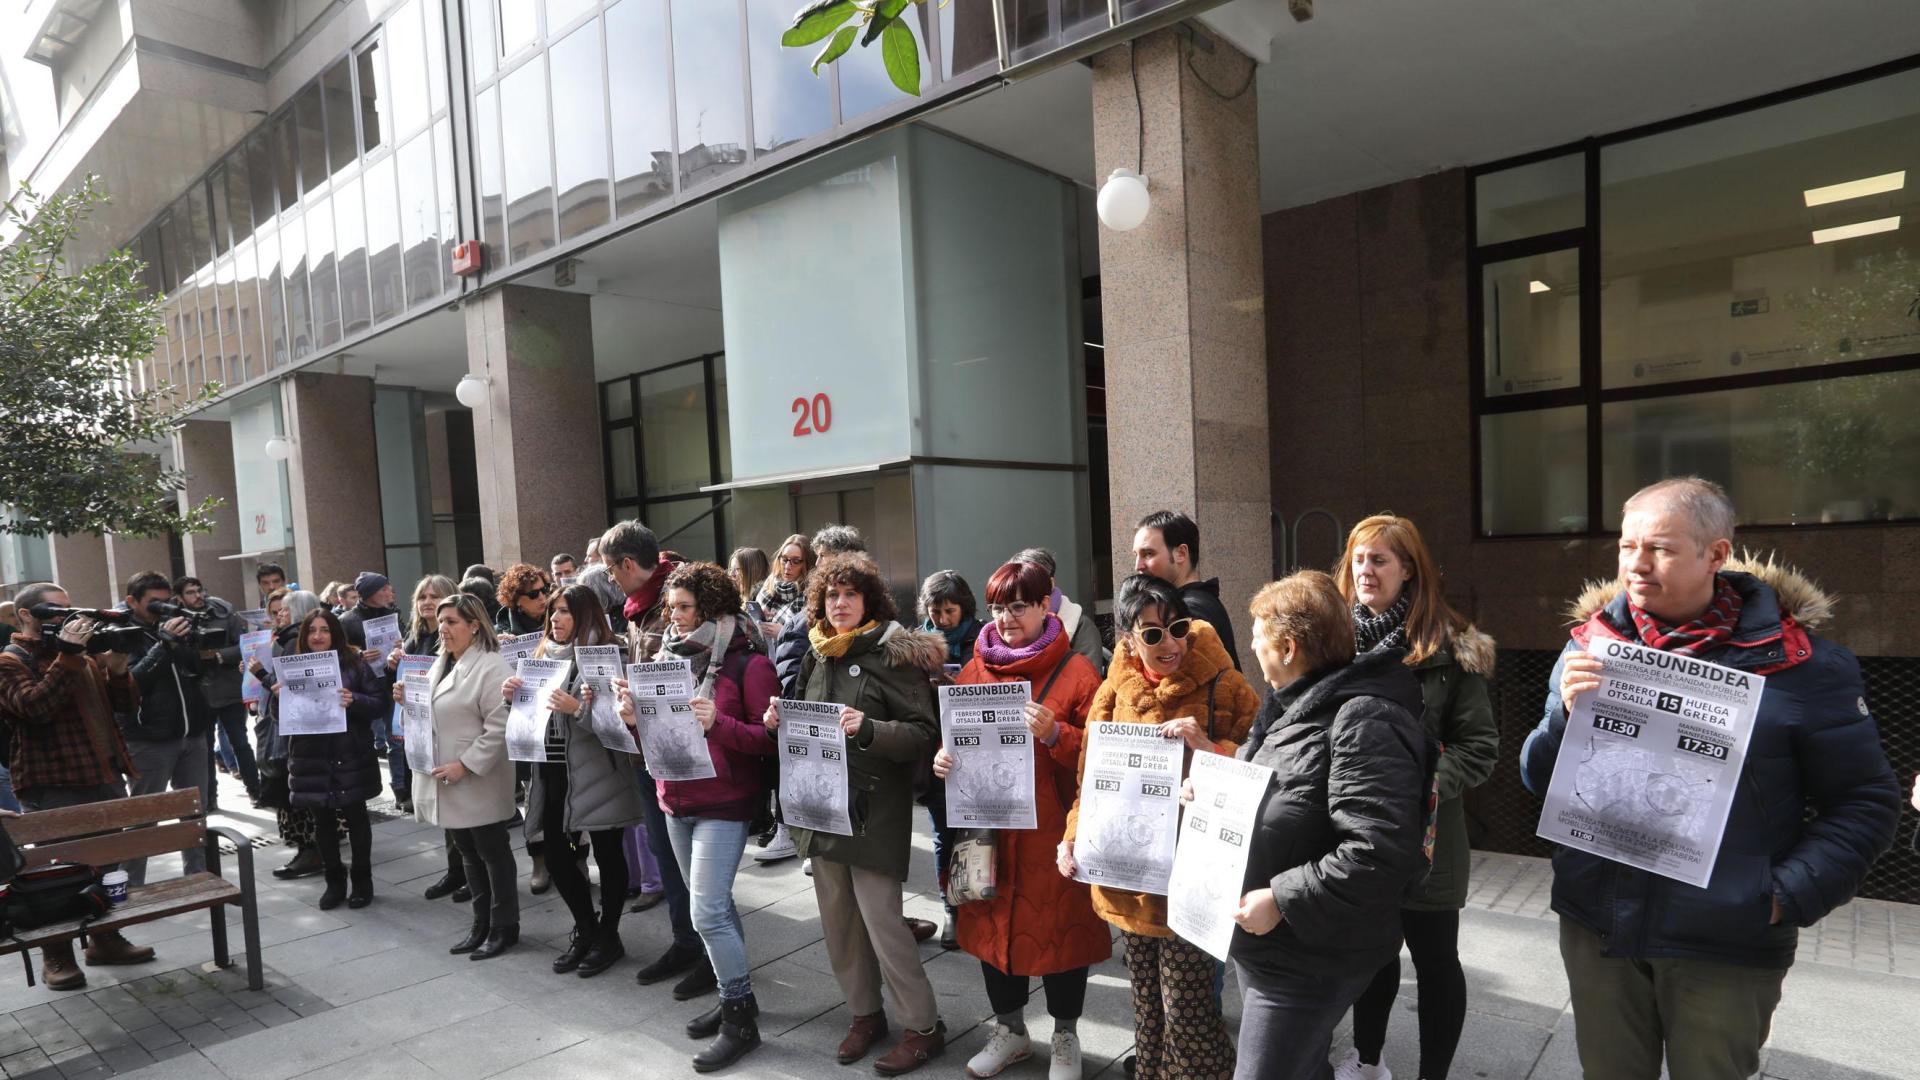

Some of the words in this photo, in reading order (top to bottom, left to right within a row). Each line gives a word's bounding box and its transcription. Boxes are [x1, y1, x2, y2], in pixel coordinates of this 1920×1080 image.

[792, 393, 831, 437] 20
[256, 514, 266, 534] 22
[280, 652, 334, 664] OSASUNBIDEA
[633, 662, 686, 673] OSASUNBIDEA
[1607, 642, 1750, 690] OSASUNBIDEA
[1614, 660, 1649, 675] DEFENSA
[1650, 668, 1661, 677] DE
[1662, 671, 1672, 680] LA
[1675, 674, 1710, 688] SANIDAD
[1713, 683, 1748, 698] PÚBLICA
[948, 685, 1025, 696] OSASUNBIDEA
[1610, 680, 1656, 698] FEBRERO
[1661, 696, 1678, 710] 15
[1686, 699, 1729, 716] HUELGA
[783, 701, 839, 714] OSASUNBIDEA
[1608, 690, 1652, 707] OTSAILA
[1683, 709, 1726, 726] GREBA
[984, 712, 994, 721] 15
[1592, 702, 1649, 718] CONCENTRACIÓN
[1679, 723, 1736, 742] MANIFESTACIÓN
[1592, 707, 1647, 724] KONTZENTRAZIOA
[1677, 729, 1734, 747] MANIFESTAZIOA
[1002, 735, 1024, 743] 17:30
[1598, 718, 1635, 735] 11:30
[1683, 738, 1723, 758] 17:30
[790, 746, 806, 754] 11:30
[824, 751, 839, 759] 17:30
[1130, 756, 1140, 766] 15
[1097, 781, 1118, 790] 11:30
[1144, 785, 1168, 795] 17:30
[1572, 830, 1592, 841] 11:00
